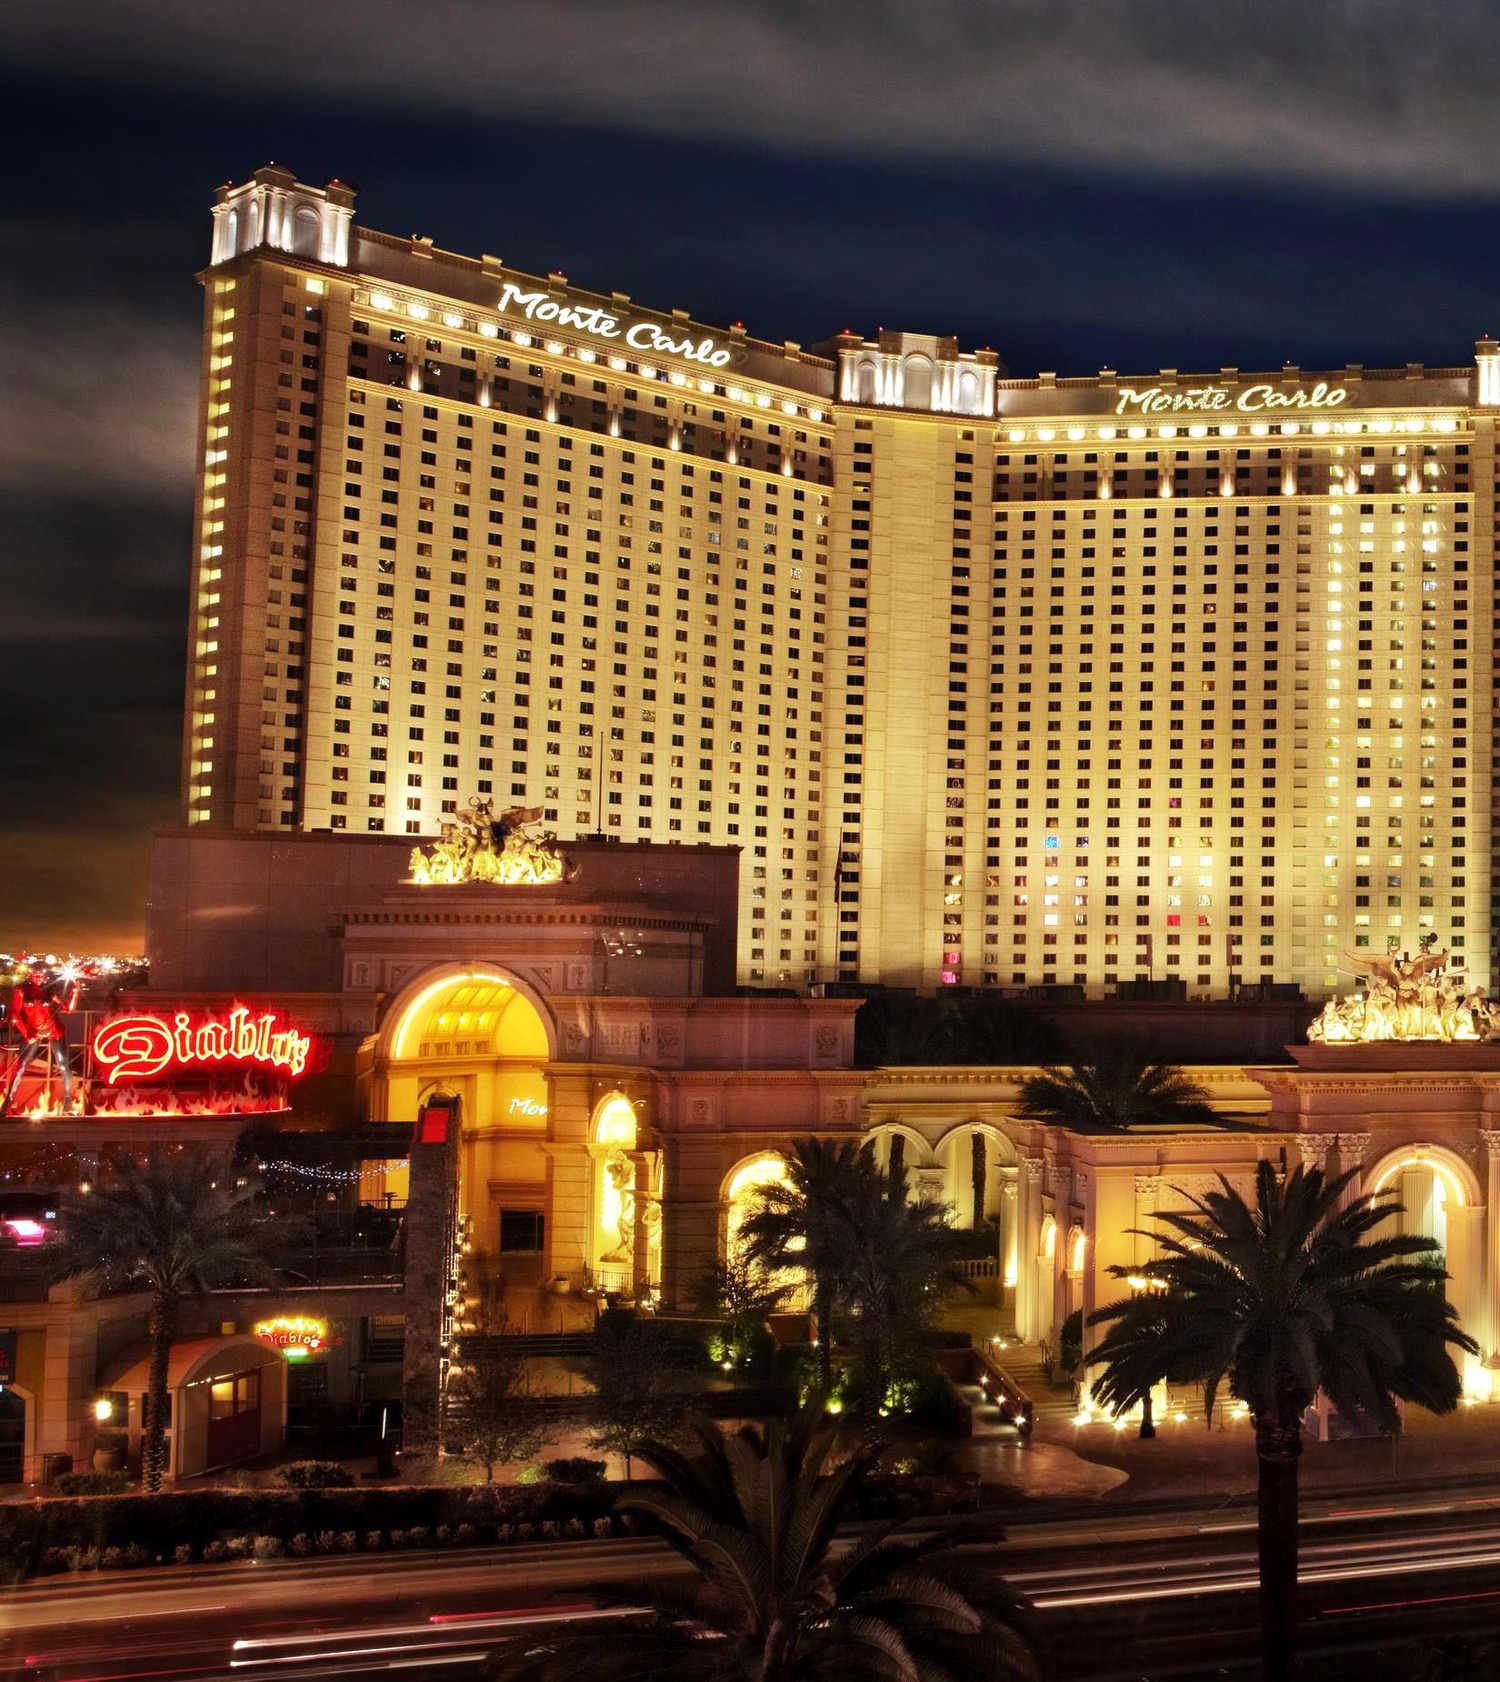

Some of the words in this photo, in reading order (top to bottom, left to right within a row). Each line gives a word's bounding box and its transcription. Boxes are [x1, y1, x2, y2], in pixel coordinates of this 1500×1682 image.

[497, 283, 621, 338] Monte
[626, 323, 731, 368] Carlo
[1115, 386, 1232, 415] Monte
[1237, 383, 1346, 412] Carlo
